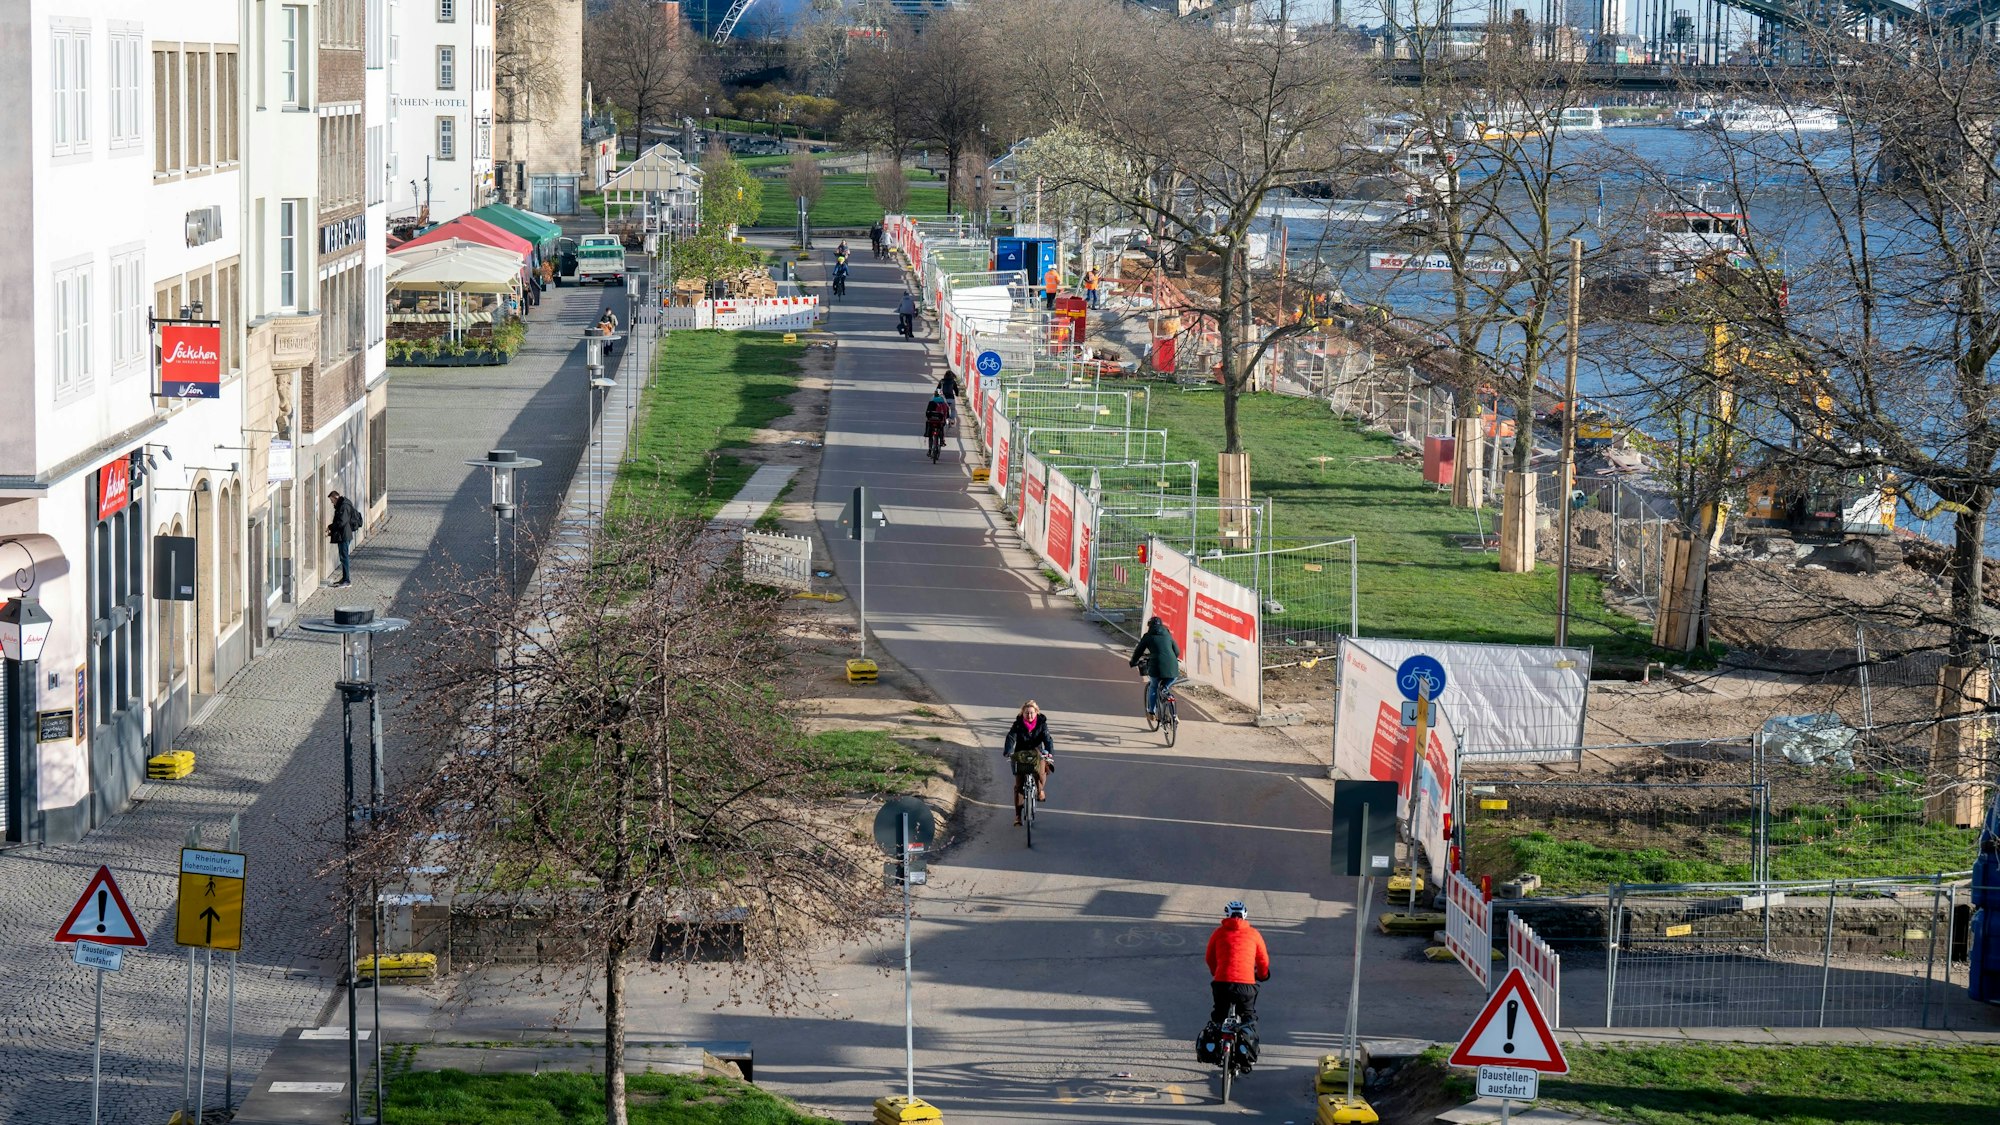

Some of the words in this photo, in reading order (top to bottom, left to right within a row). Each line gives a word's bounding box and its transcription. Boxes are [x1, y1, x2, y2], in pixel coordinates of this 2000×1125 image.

[163, 341, 218, 364] Söckchen
[177, 382, 204, 397] Sion
[195, 853, 232, 865] Rheinufer
[81, 944, 119, 957] Baustellen-
[84, 955, 112, 966] ausfahrt
[1482, 1068, 1534, 1083] Baustellen-
[1488, 1083, 1527, 1096] ausfahrt
